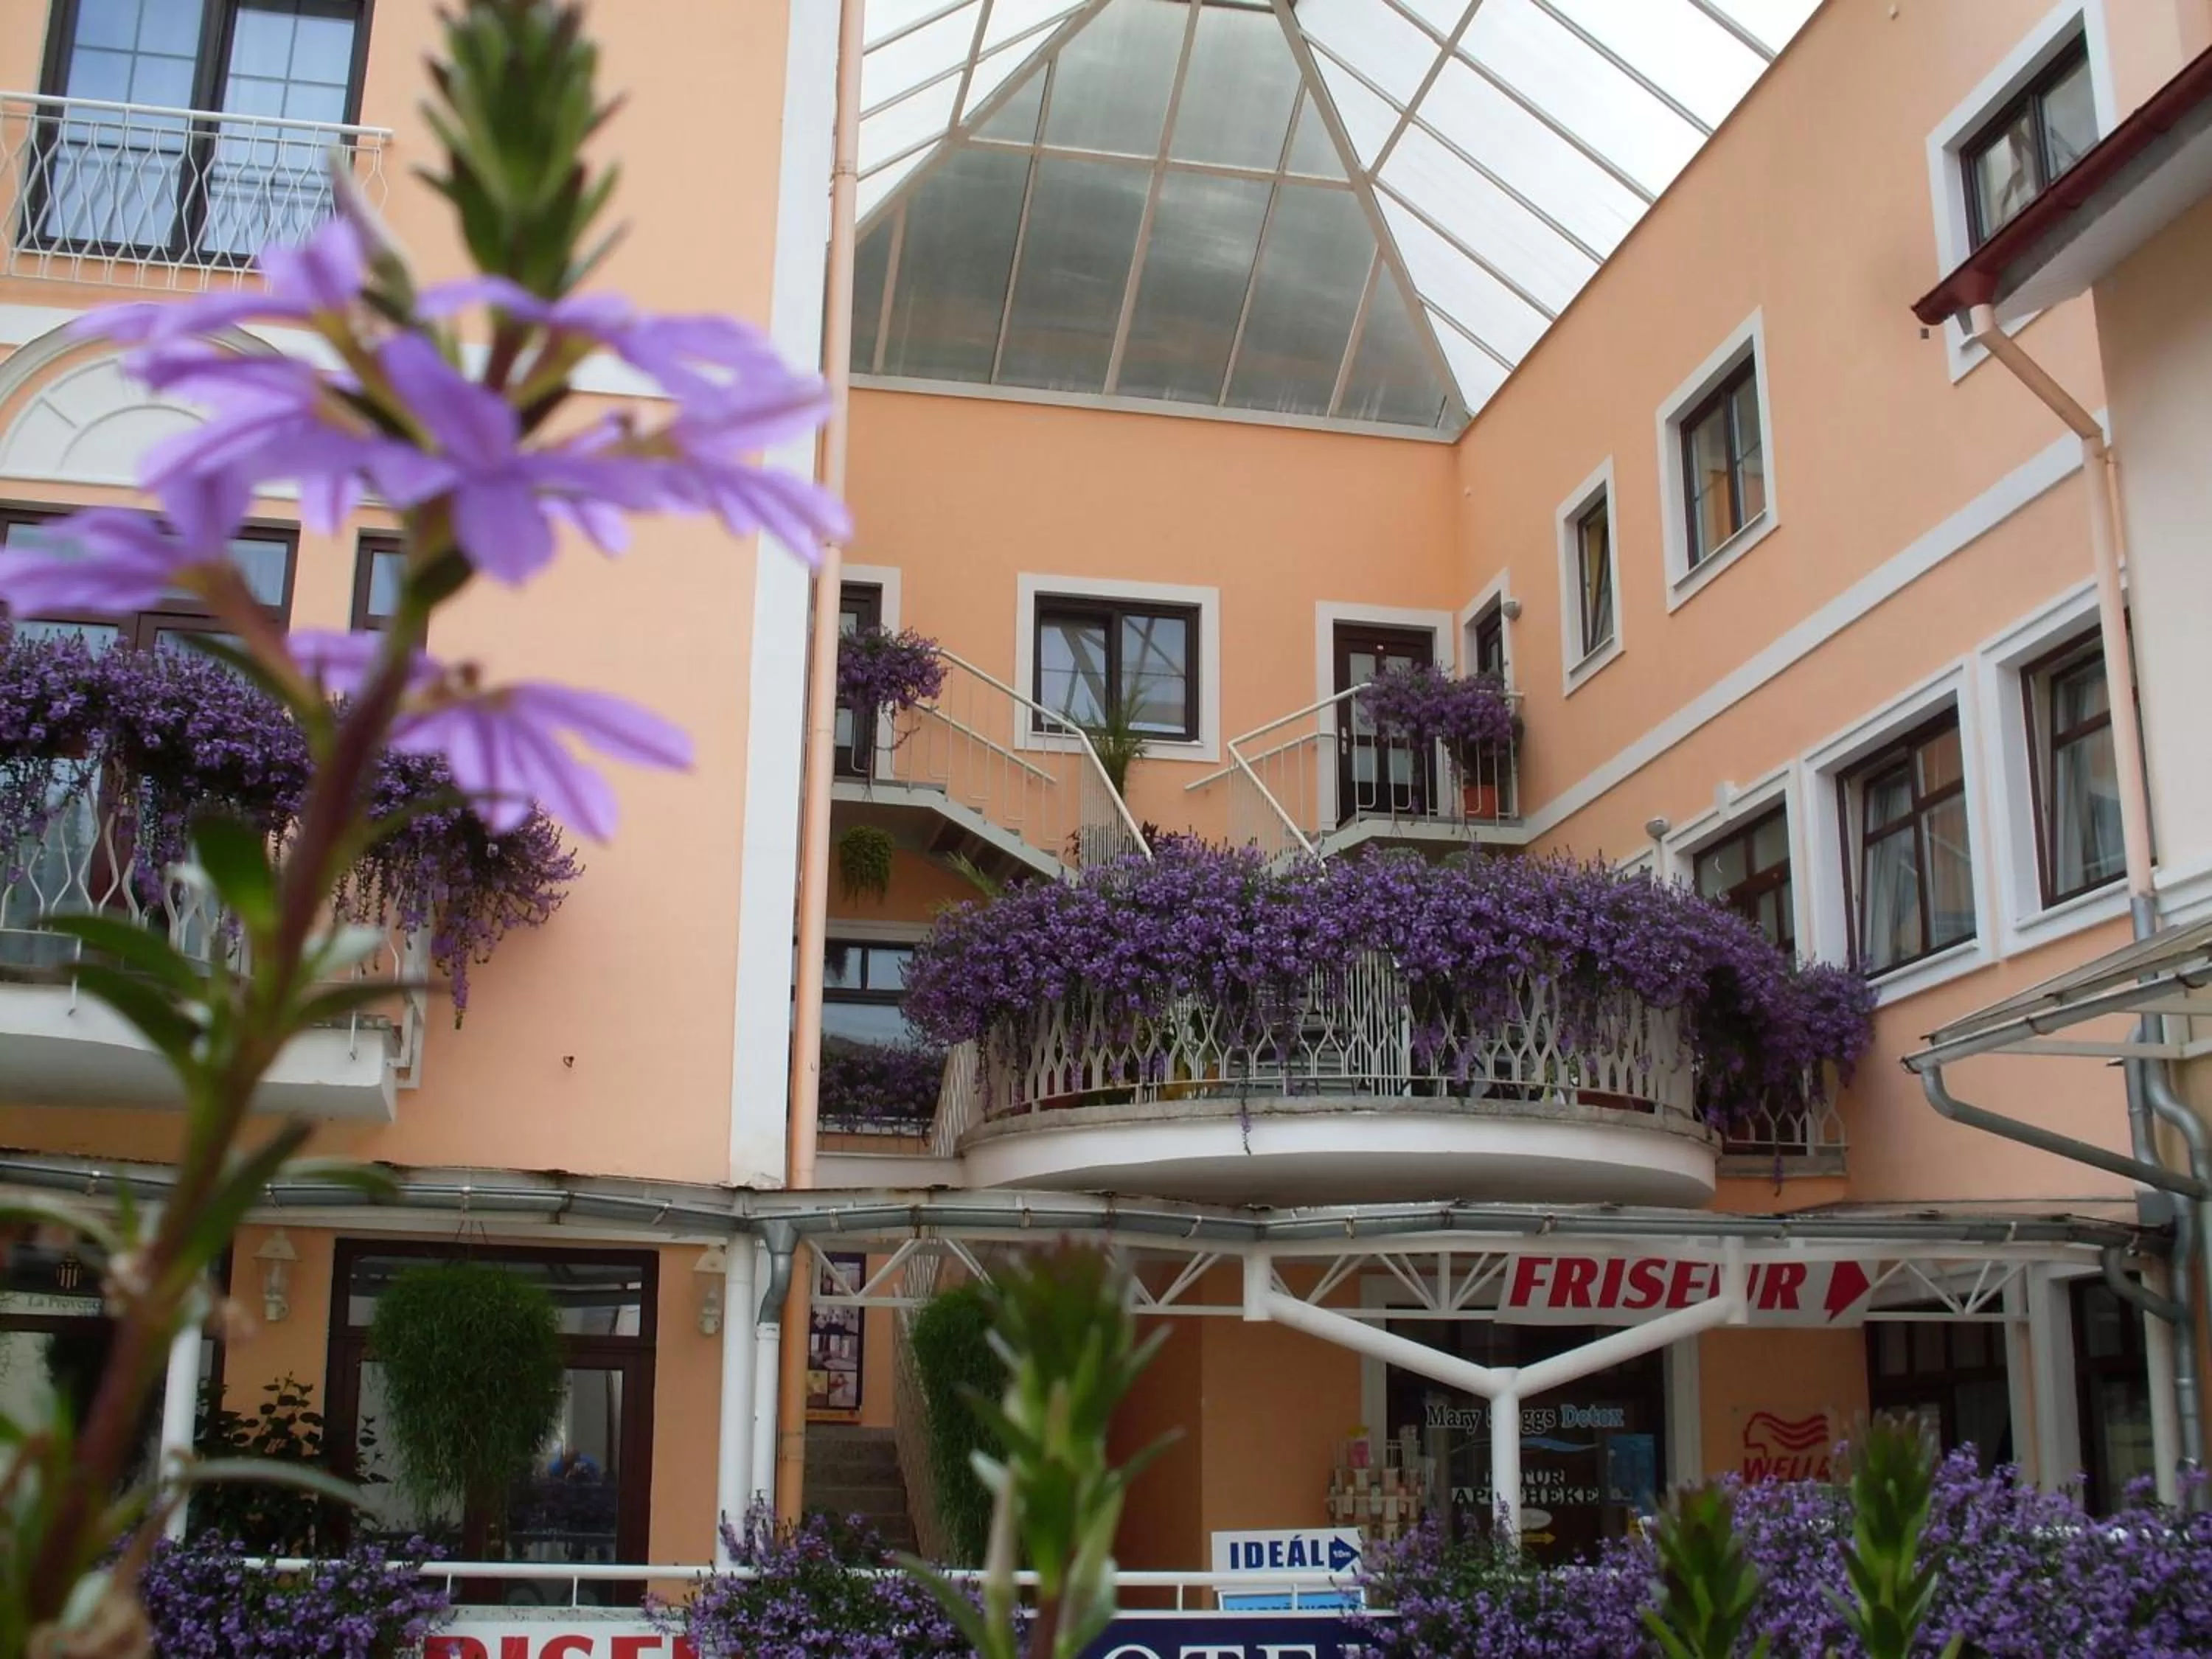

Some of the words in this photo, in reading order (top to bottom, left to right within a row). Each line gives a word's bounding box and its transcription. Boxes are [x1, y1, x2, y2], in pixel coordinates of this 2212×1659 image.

[1427, 1404, 1480, 1434] Mary
[1486, 1404, 1557, 1434] ggs
[1562, 1404, 1624, 1427] Detox
[1484, 1469, 1566, 1485] TUR
[1451, 1486, 1600, 1505] APHEKE
[1230, 1534, 1325, 1570] IDEÁL
